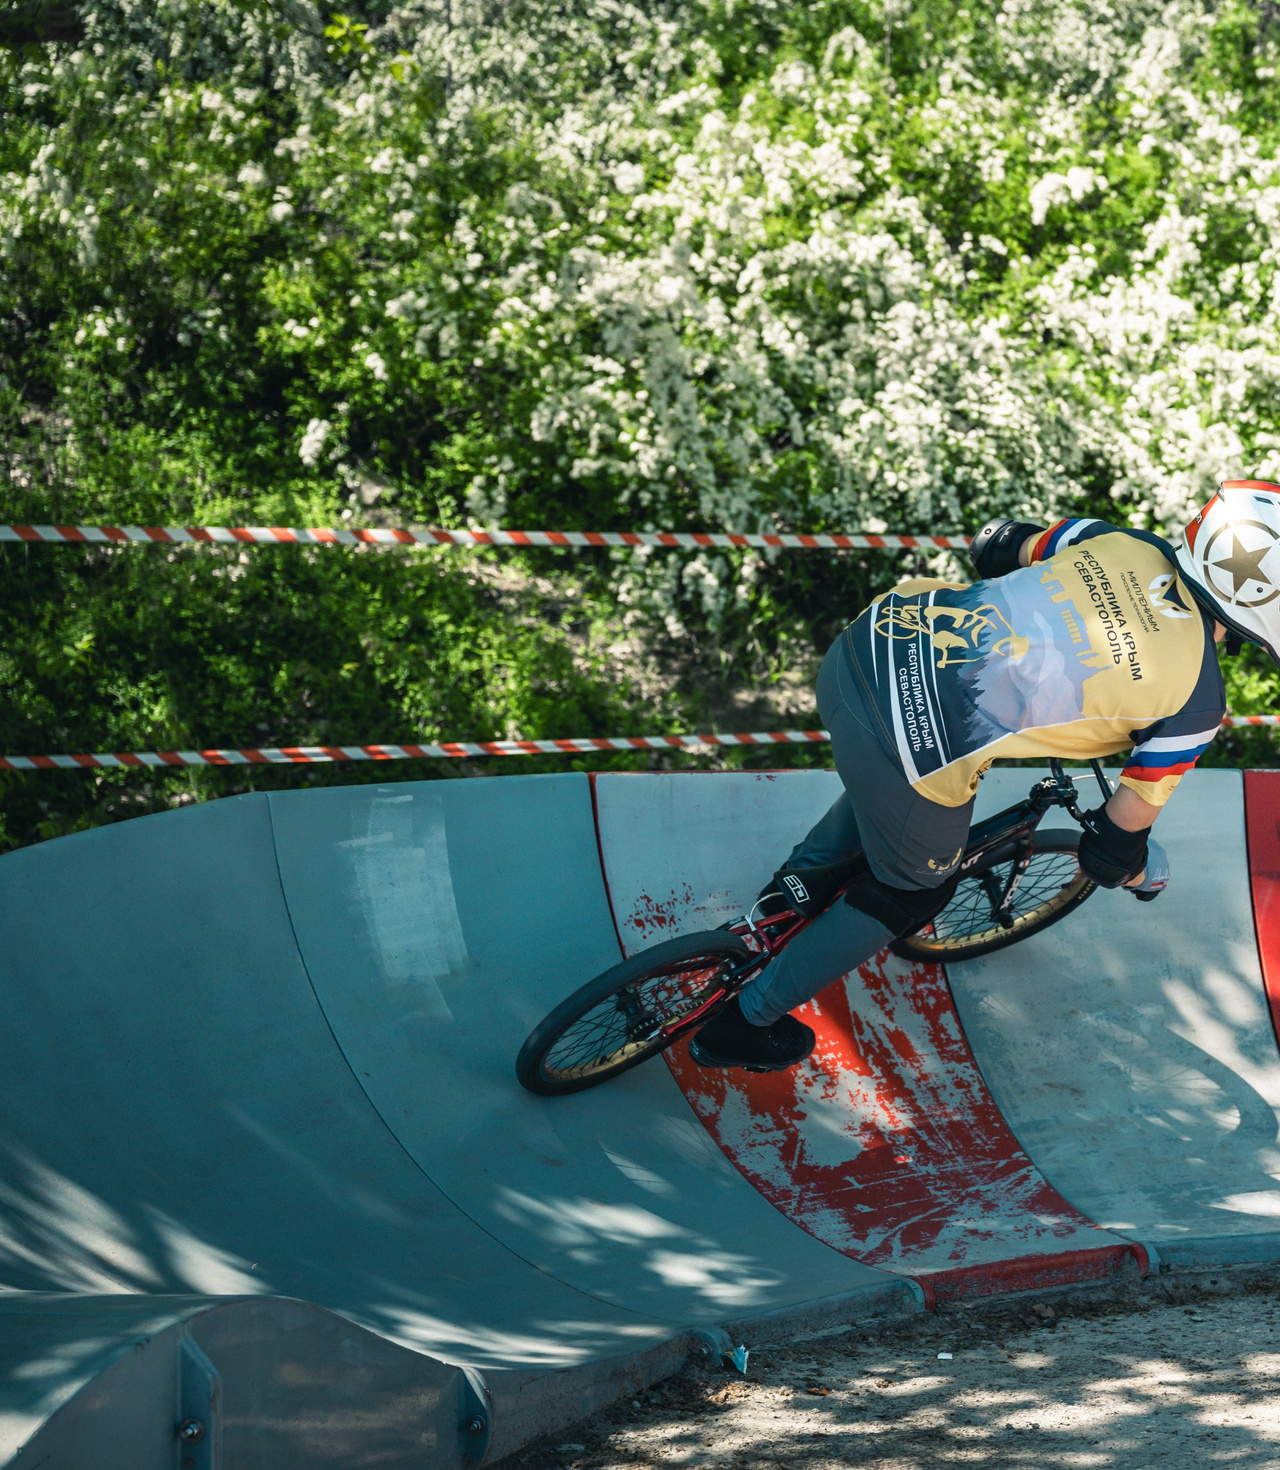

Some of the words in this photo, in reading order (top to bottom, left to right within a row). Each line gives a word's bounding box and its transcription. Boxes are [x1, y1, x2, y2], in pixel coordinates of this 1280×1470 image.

[1073, 561, 1123, 665] СЕВАСТОПОЛЬ
[1078, 550, 1127, 628] РЕСПУБЛИКА
[1122, 631, 1143, 681] КРЫМ
[1127, 571, 1160, 632] МИЛЛЕНИУМ
[899, 668, 920, 752] СЕВАСТОПОЛЬ
[908, 643, 925, 714] РЕСПУБЛИКА
[918, 716, 935, 749] КРЫМ
